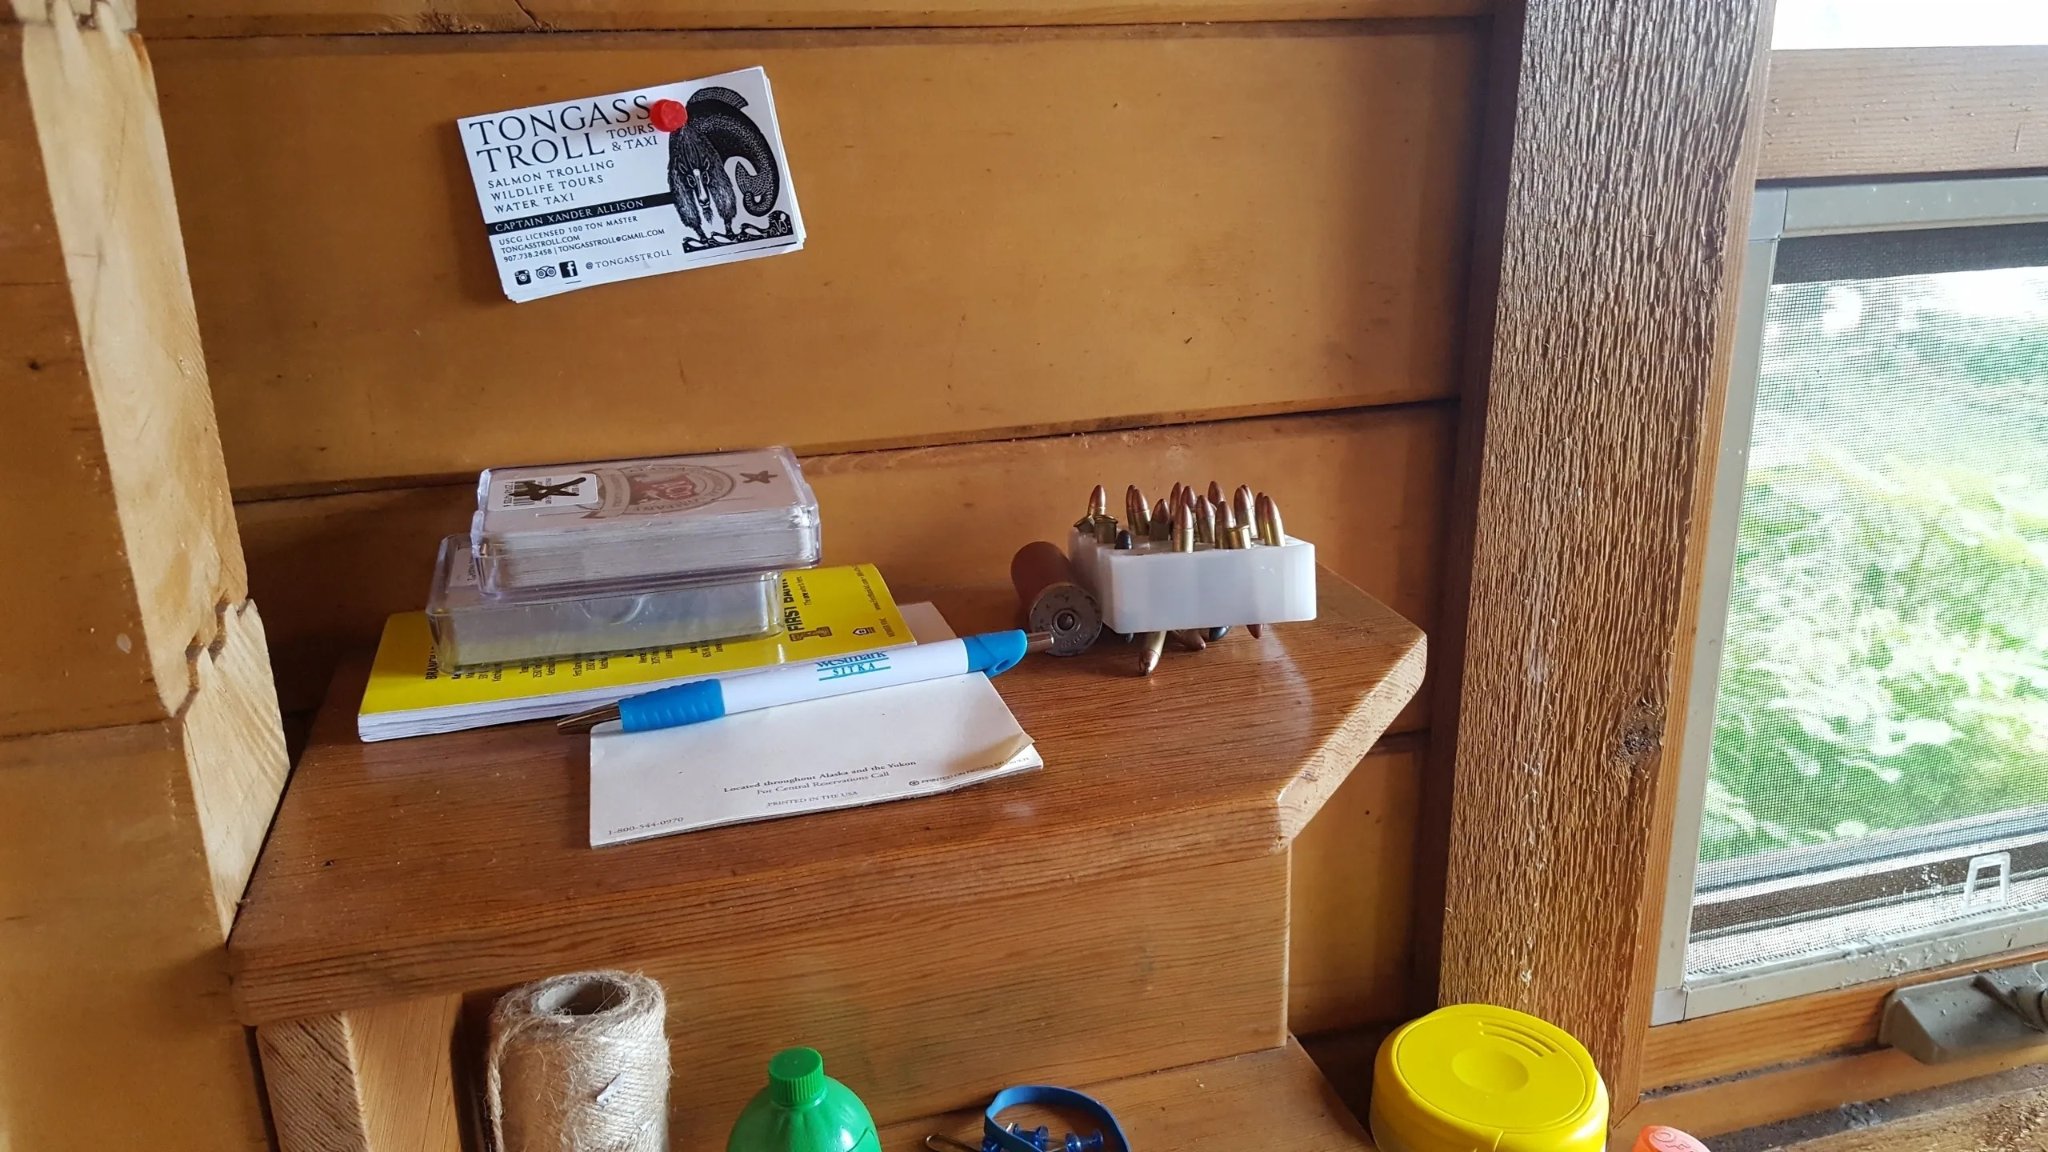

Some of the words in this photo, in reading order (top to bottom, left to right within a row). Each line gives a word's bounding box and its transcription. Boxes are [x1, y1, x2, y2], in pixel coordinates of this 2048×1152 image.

[469, 95, 651, 146] TONGASS
[606, 122, 655, 139] TOURS
[476, 132, 605, 173] TROLL
[611, 141, 622, 152] &
[624, 135, 658, 150] TAXI
[488, 172, 542, 189] SALMON
[546, 159, 615, 179] TROLLING
[490, 182, 555, 201] WILDLIFE
[558, 174, 604, 190] TOURS
[494, 198, 539, 215] WATER
[543, 192, 575, 206] TAXI
[495, 216, 544, 232] CAPTAIN
[548, 208, 593, 224] XANDER
[597, 200, 645, 215] ALLISON
[499, 235, 523, 246] USCG
[525, 228, 565, 243] LICENSED
[568, 225, 583, 234] 100
[585, 221, 603, 231] TON
[605, 215, 638, 227] MASTER
[558, 228, 665, 253] TONGASSTROLL@GMAIL.COM
[501, 234, 580, 254] TONGASSTROLL.COM
[833, 663, 876, 676] SITKA
[723, 781, 760, 793] Located
[764, 774, 816, 787] throughout
[819, 770, 849, 780] Alaska
[851, 767, 868, 776] and
[871, 763, 886, 772] the
[888, 760, 917, 769] Yukon
[776, 782, 810, 793] Central
[813, 775, 869, 788] Reservations
[871, 770, 890, 780] Call
